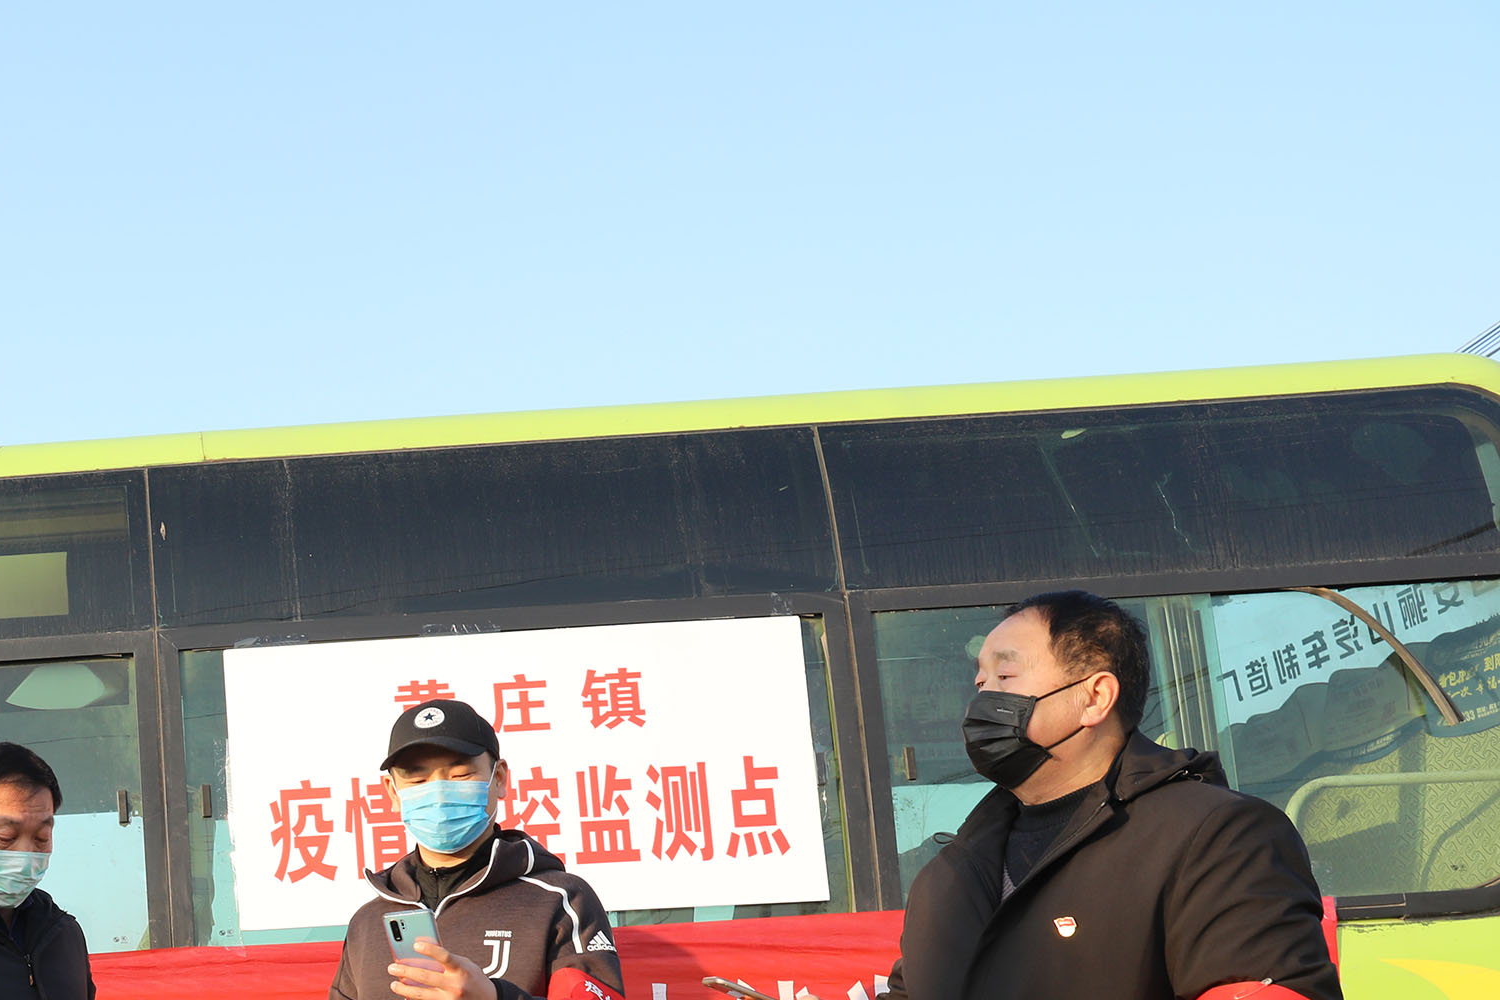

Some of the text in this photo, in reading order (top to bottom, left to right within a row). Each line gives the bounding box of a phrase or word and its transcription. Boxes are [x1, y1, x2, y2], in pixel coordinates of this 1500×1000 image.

[269, 755, 790, 883] 疫情控监测点
[484, 930, 512, 938] JUVENTUS
